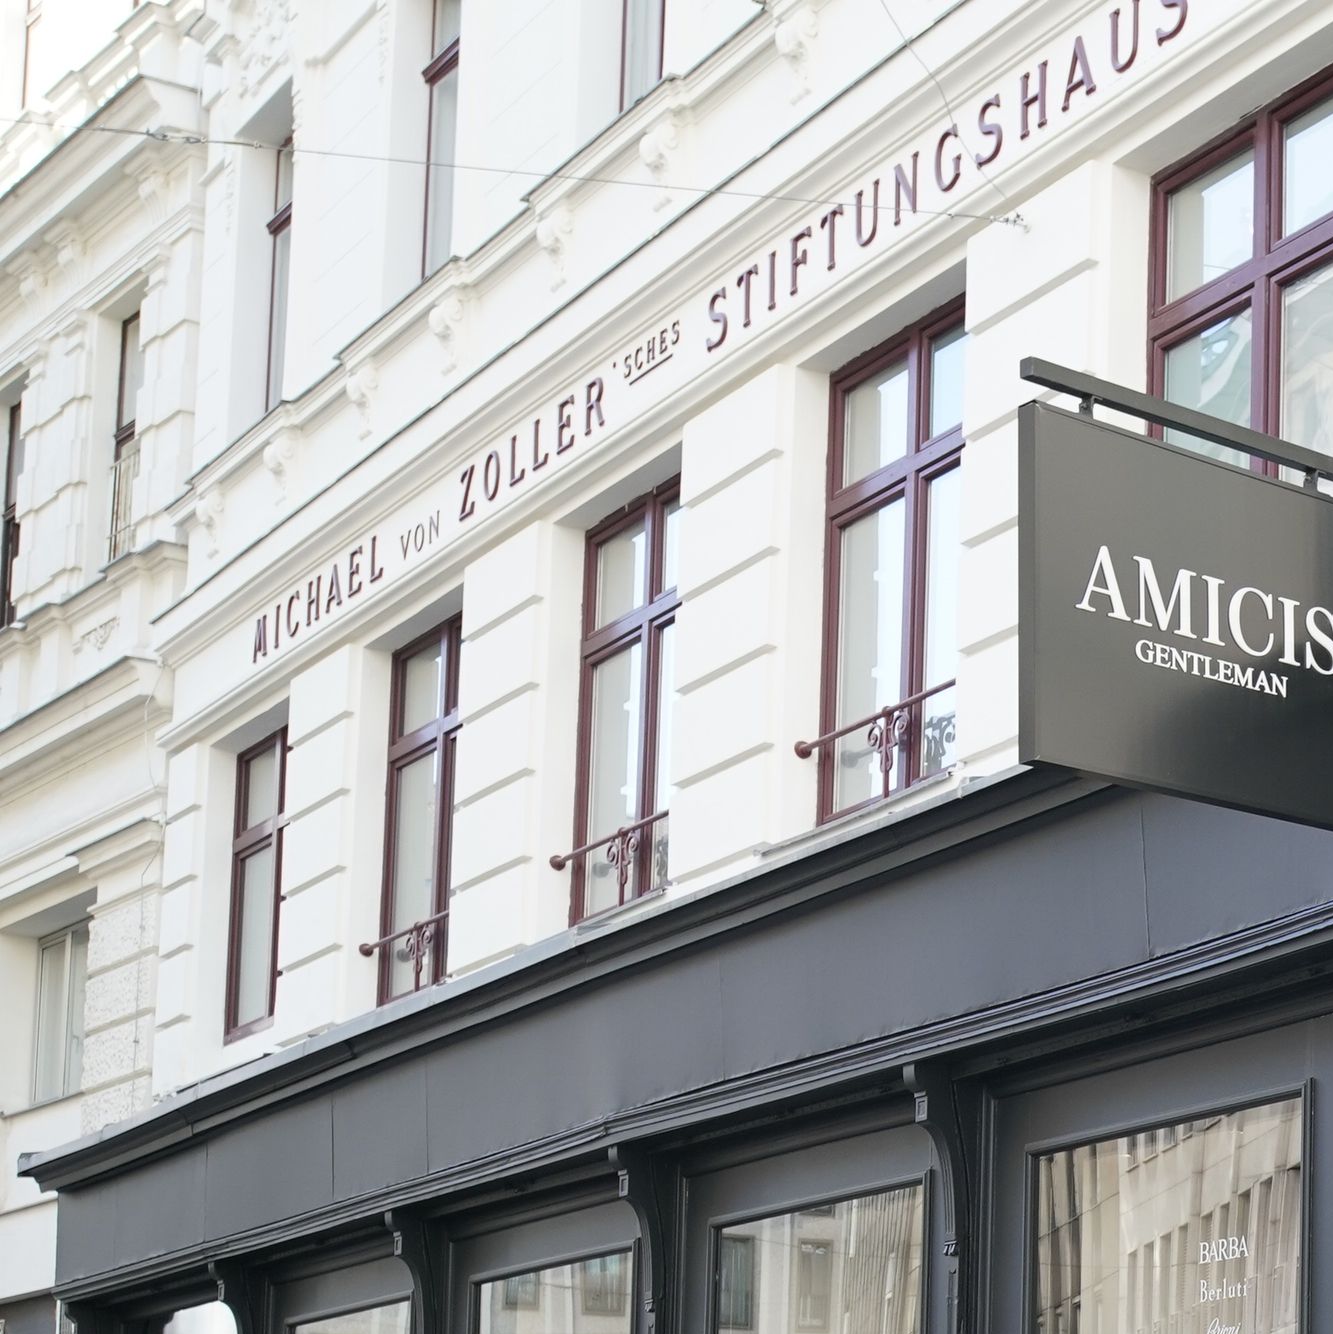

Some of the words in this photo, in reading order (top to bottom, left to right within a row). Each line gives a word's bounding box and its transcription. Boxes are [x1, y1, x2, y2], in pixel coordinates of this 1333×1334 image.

[253, 535, 384, 664] MICHAEL
[400, 509, 441, 561] VON
[459, 376, 605, 522] ZOLLER
[706, 0, 1189, 353] STIFTUNGSHAUS
[1134, 638, 1289, 699] GENTLEMAN
[1199, 1234, 1250, 1265] BARBA
[1199, 1277, 1248, 1304] Berluti
